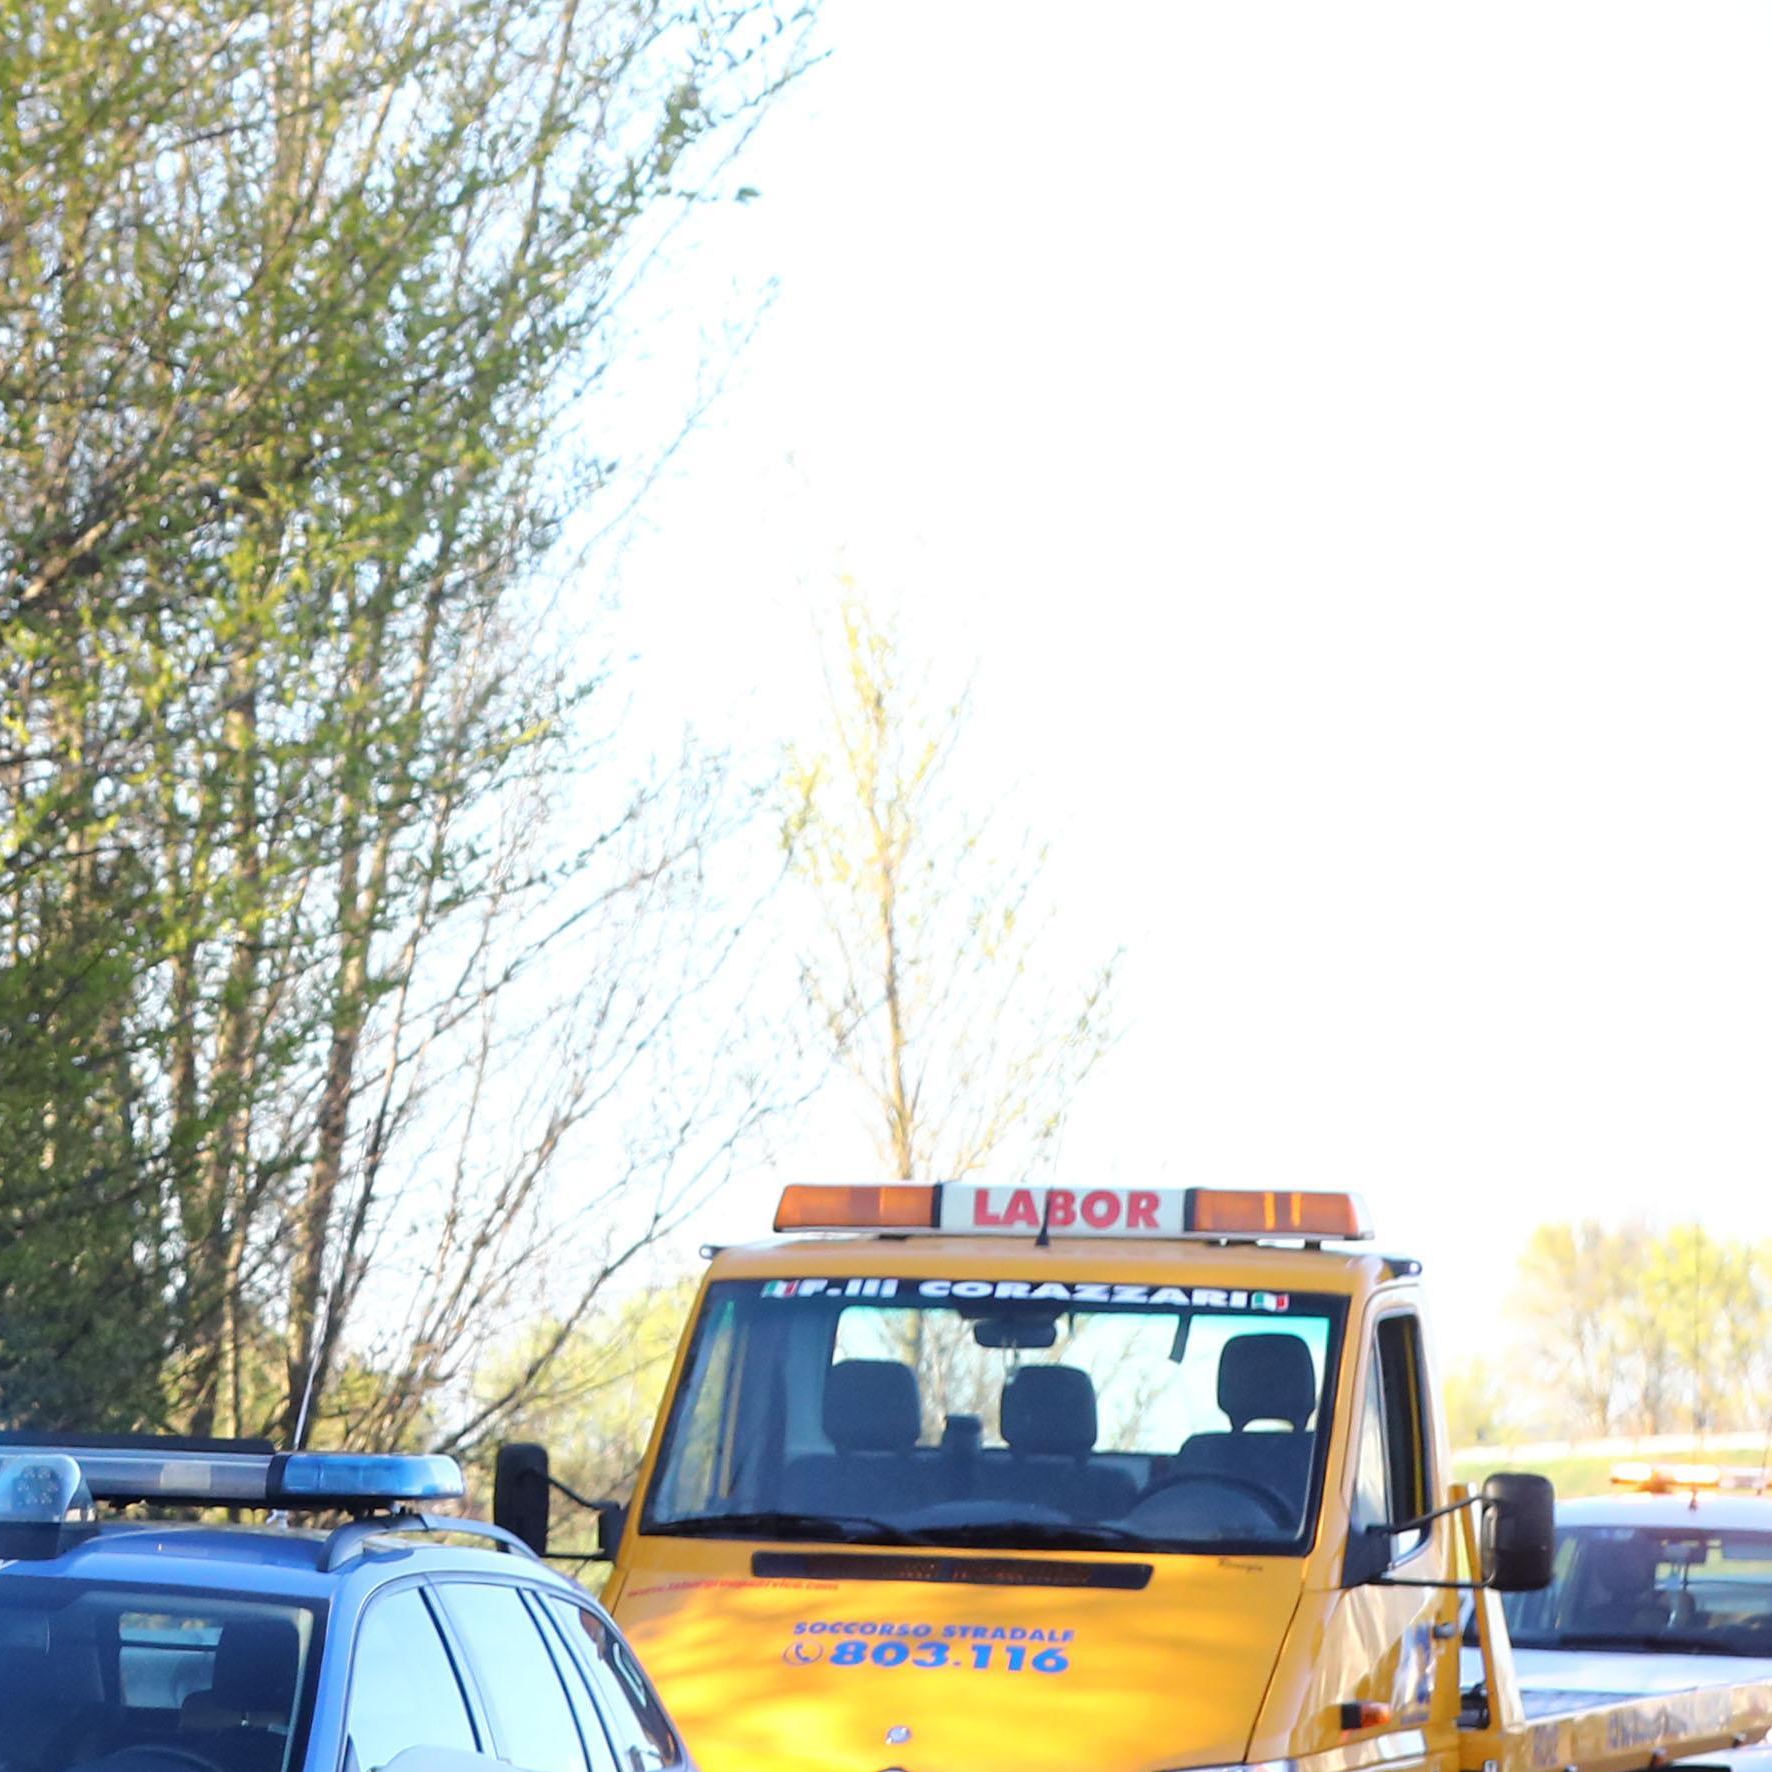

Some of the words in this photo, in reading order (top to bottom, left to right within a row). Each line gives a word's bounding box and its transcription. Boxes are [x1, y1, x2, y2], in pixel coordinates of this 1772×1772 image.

[973, 1188, 1161, 1230] LABOR
[918, 1280, 1248, 1308] CORAZZARI
[793, 1622, 933, 1638] SOCCORSO
[942, 1624, 1075, 1642] STRADALE
[829, 1639, 1070, 1674] 803.116
